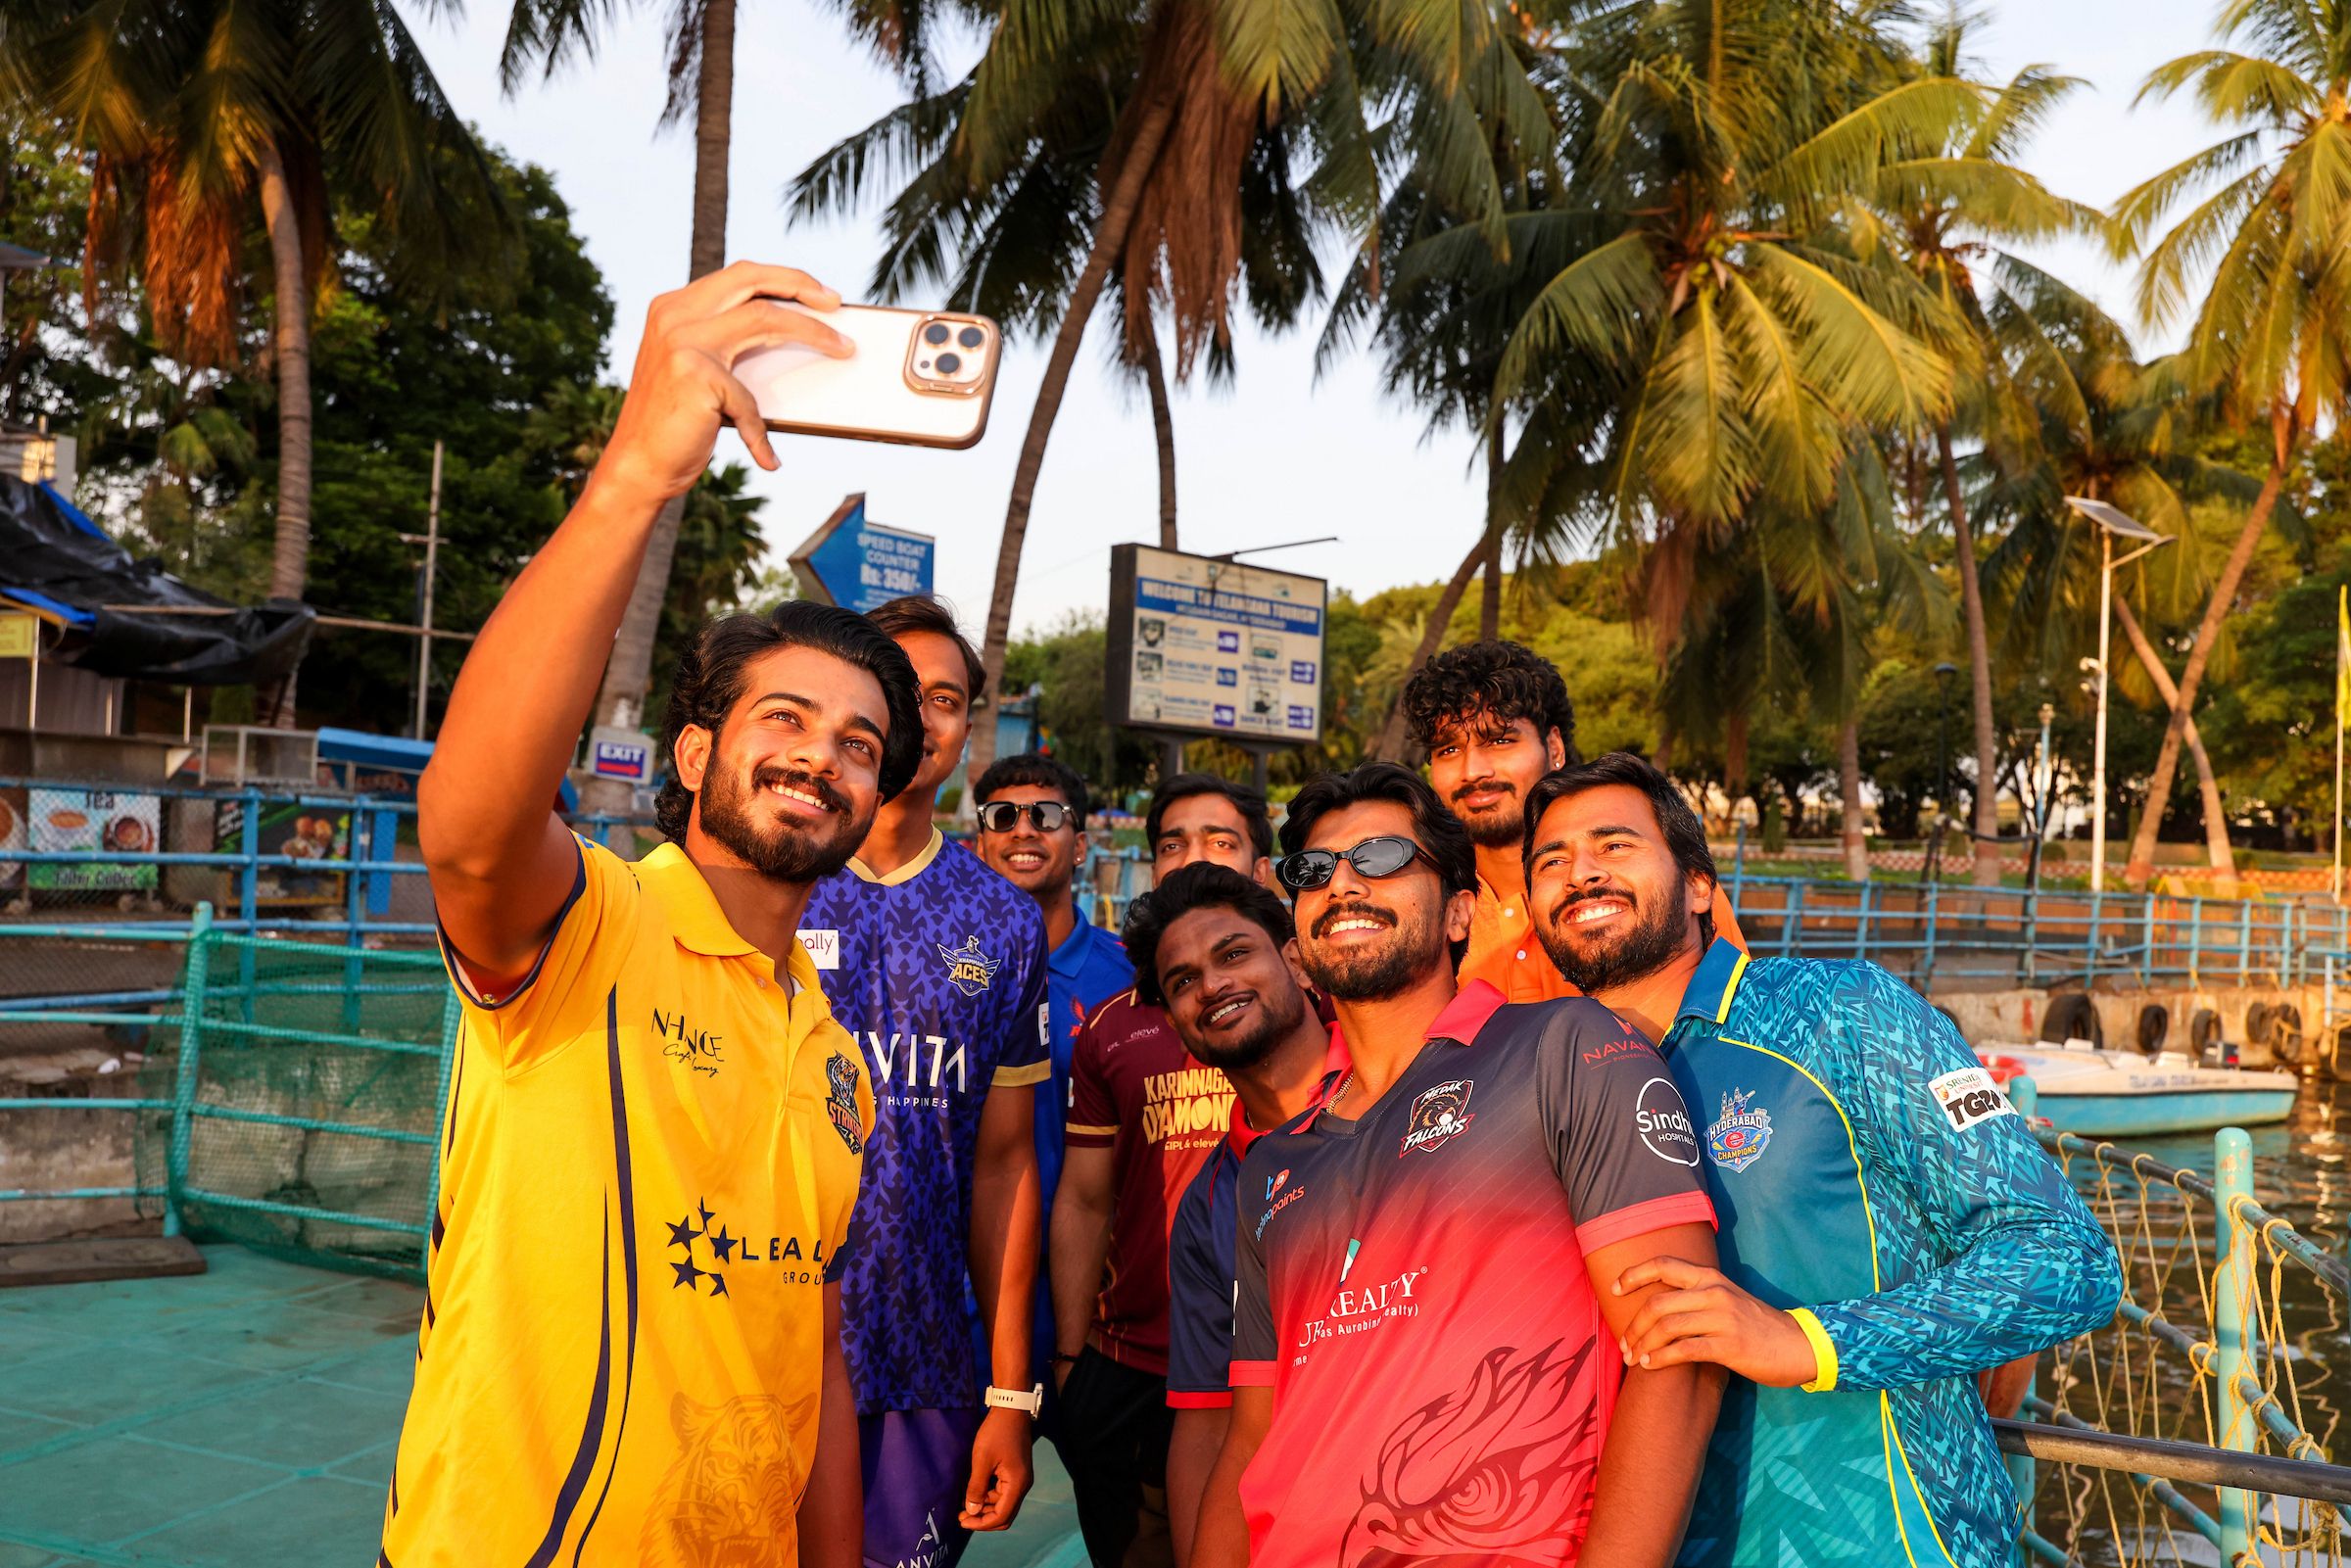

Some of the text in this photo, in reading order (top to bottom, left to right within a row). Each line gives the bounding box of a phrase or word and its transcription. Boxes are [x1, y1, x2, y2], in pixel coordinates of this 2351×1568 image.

[857, 532, 926, 558] SPEED BOAT
[866, 549, 920, 570] COUNTER
[600, 743, 643, 762] EXIT
[800, 933, 835, 955] ally
[951, 963, 988, 987] ACES
[1420, 1079, 1467, 1105] MEDAK
[1403, 1117, 1468, 1152] FALCONS
[1709, 1115, 1764, 1142] HYDERABAD
[1717, 1144, 1758, 1162] CHAMPIONS
